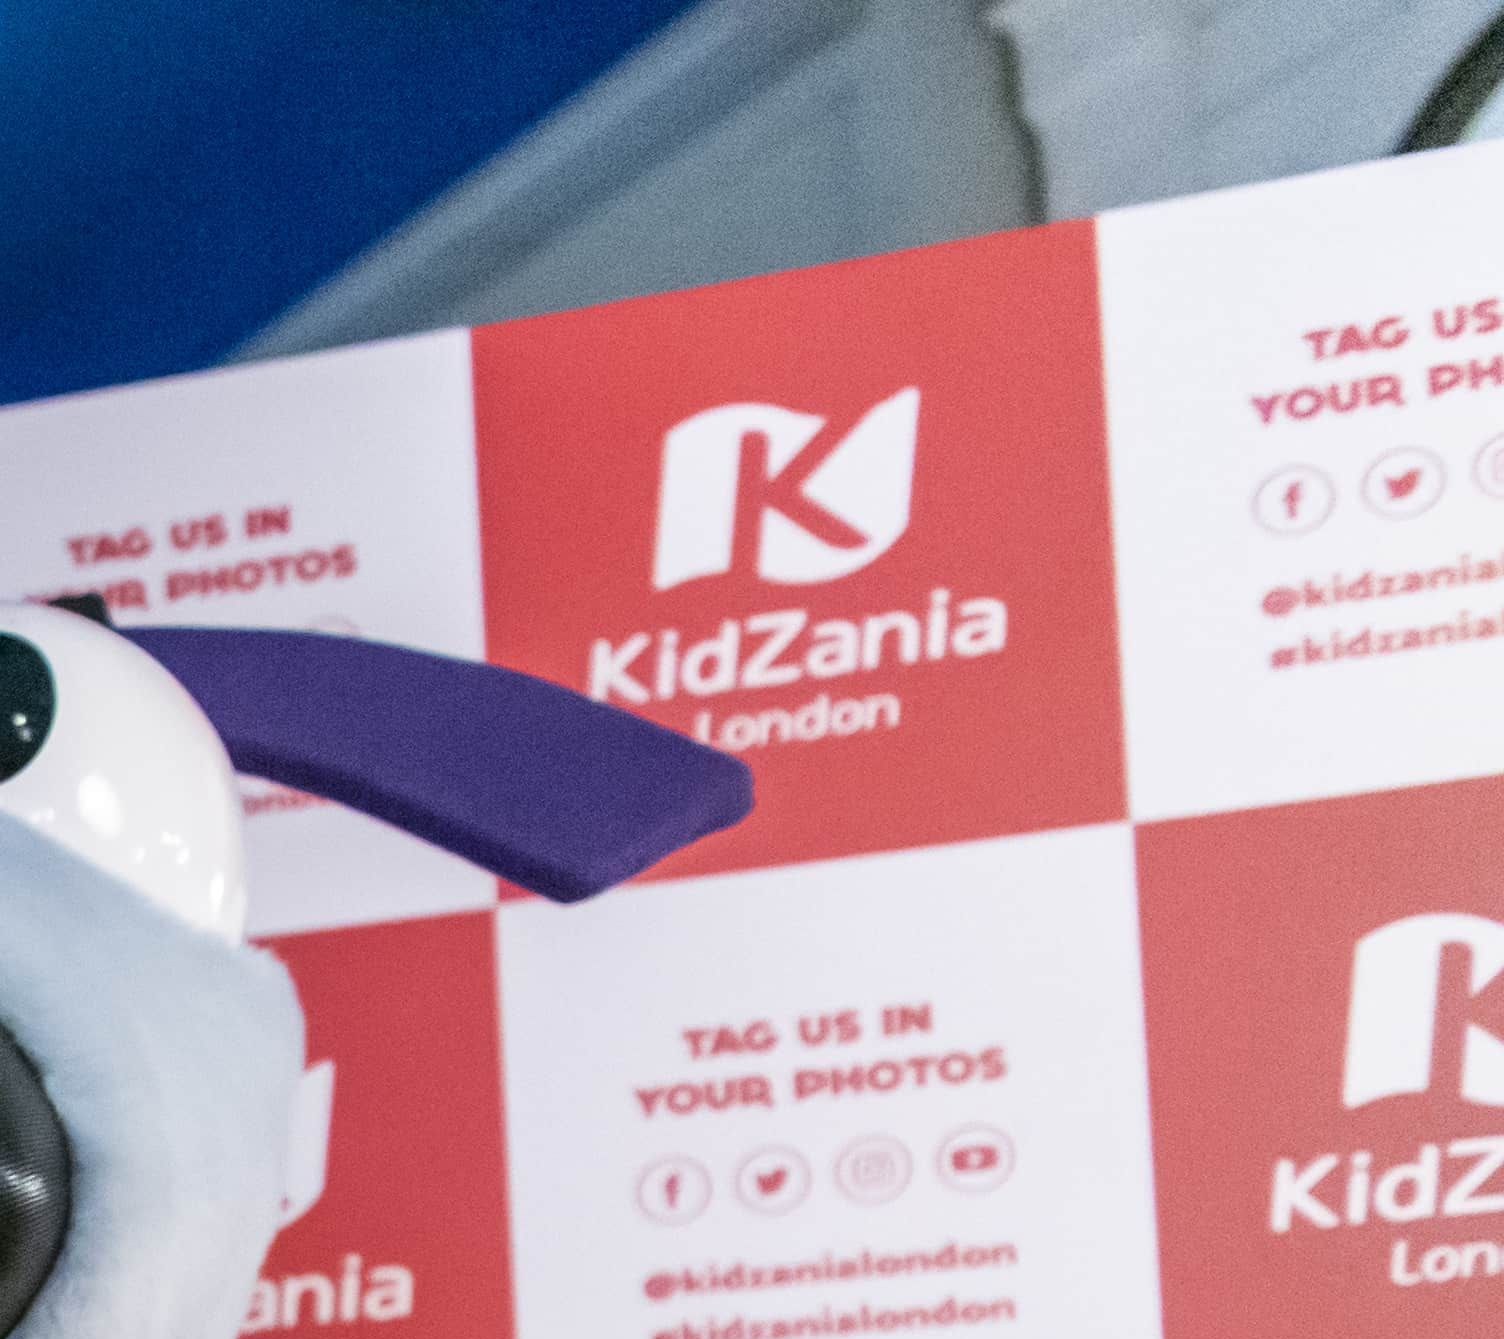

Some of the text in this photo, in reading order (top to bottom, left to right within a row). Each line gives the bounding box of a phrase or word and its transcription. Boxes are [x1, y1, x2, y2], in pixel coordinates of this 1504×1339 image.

[1304, 298, 1504, 360] TAG US
[1251, 374, 1404, 425] YOUR
[67, 506, 291, 567] TAG US IN
[164, 544, 356, 602] PHOTOS
[1260, 560, 1504, 619] @kidzania
[591, 587, 1008, 705] KidZania
[694, 694, 901, 752] London
[683, 1003, 932, 1058] TAG US IN
[635, 1048, 1006, 1117] YOUR PHOTOS
[1270, 1136, 1504, 1233] KidZ
[642, 1236, 1017, 1303] @kidzanialondon
